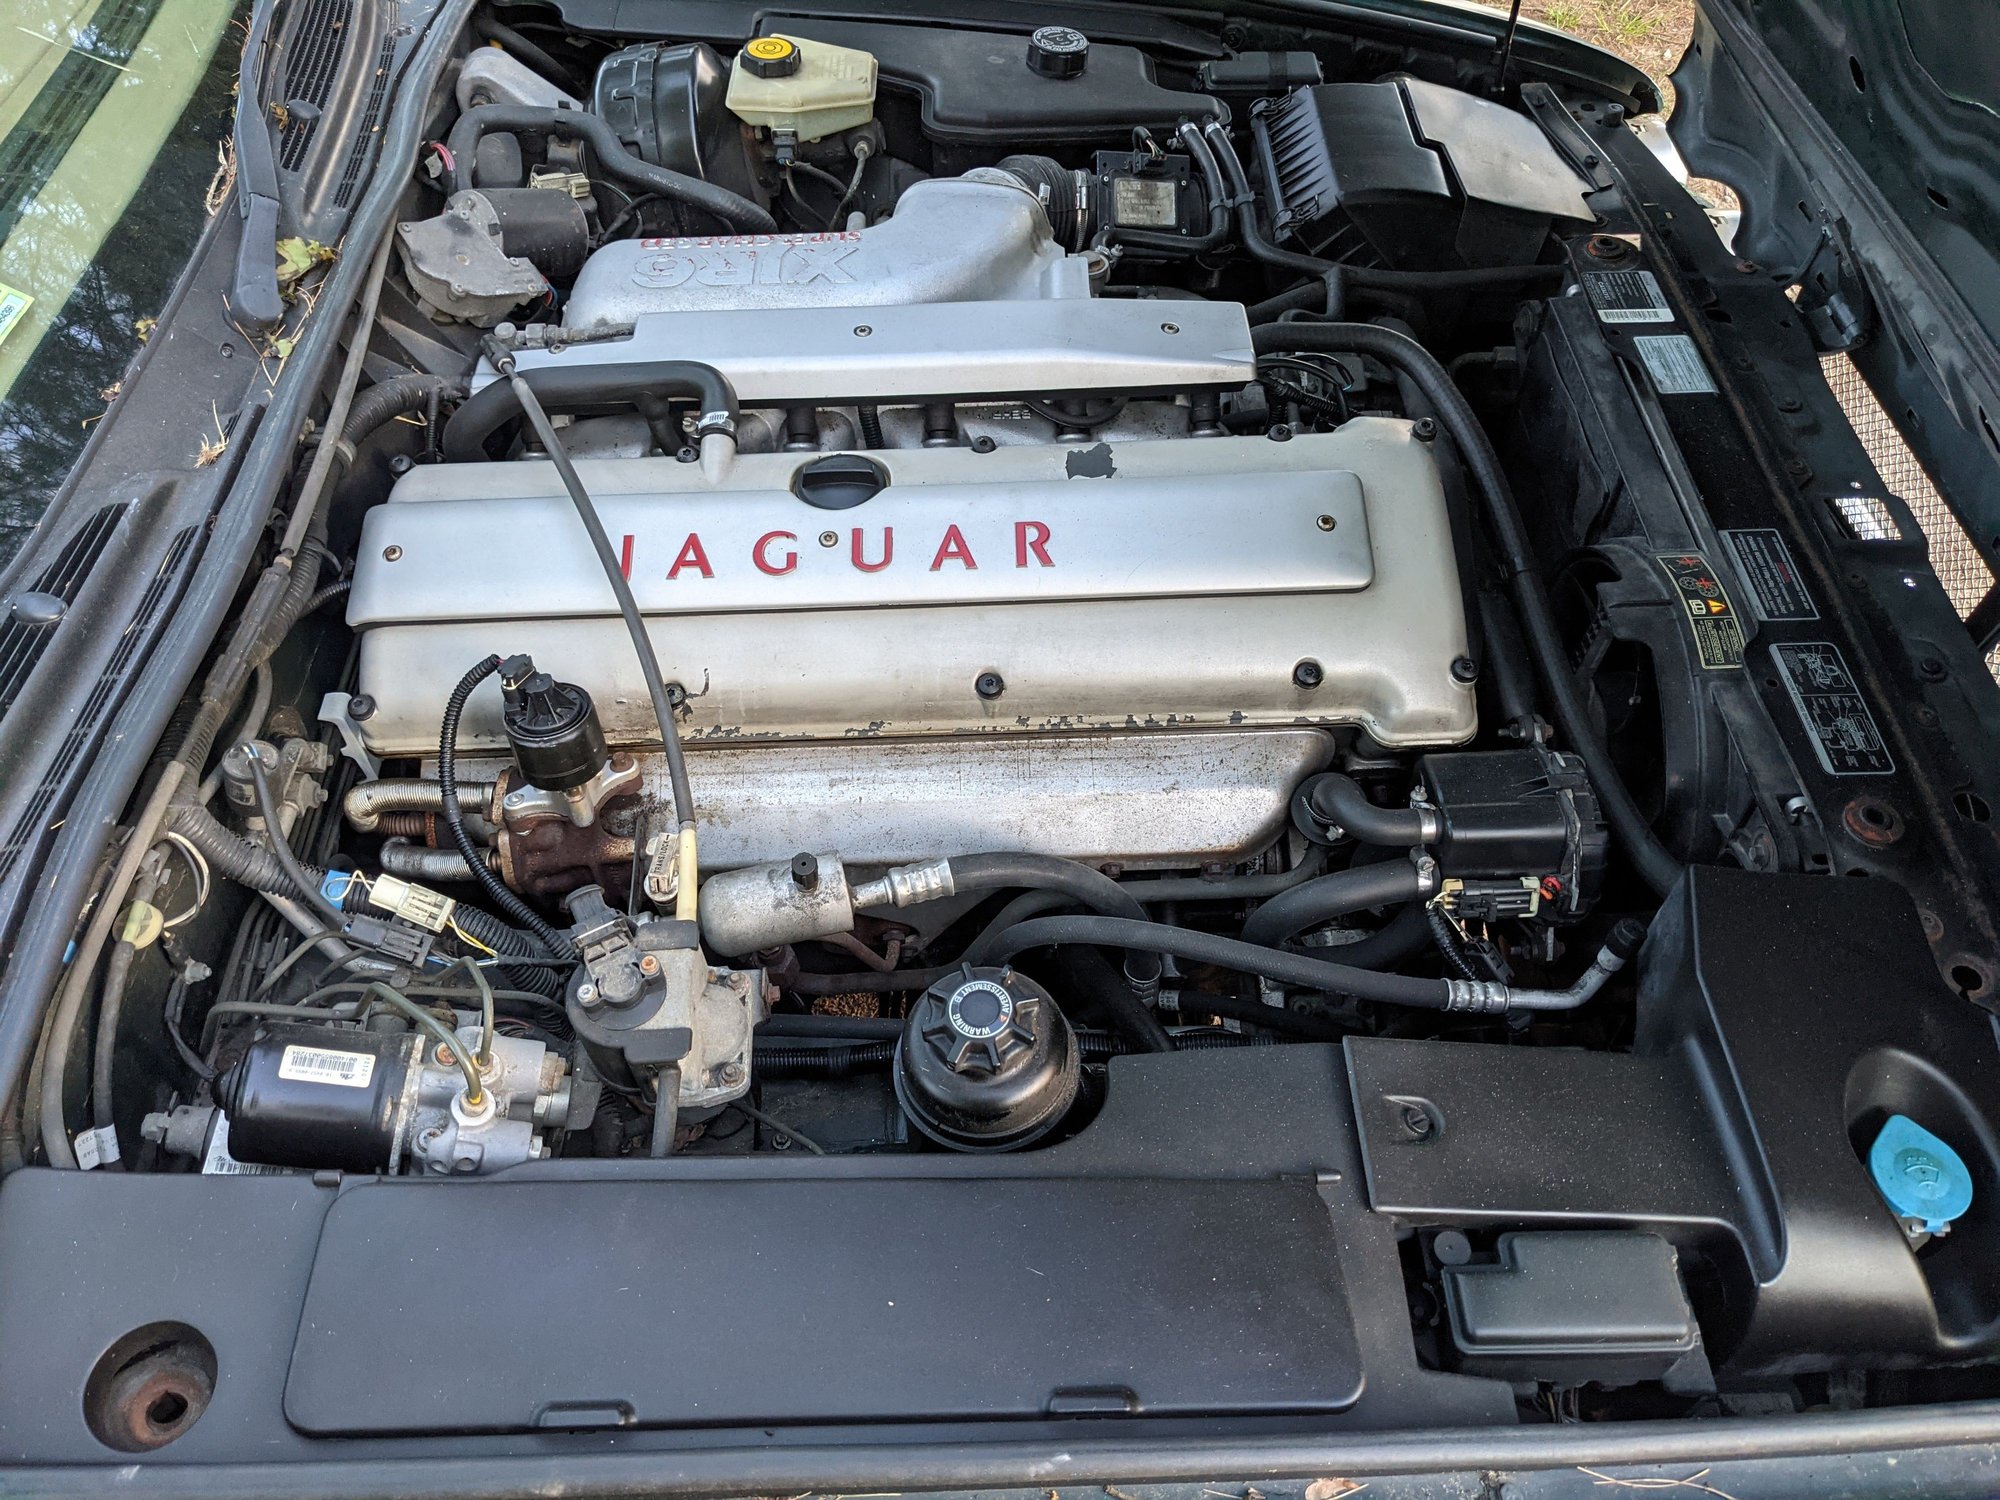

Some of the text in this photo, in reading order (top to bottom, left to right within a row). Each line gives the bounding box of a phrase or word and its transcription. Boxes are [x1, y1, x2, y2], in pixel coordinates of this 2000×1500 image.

[621, 521, 1055, 584] JAGUAR
[961, 983, 1010, 1013] AVERTISSEMENT
[953, 1013, 991, 1036] WARNING
